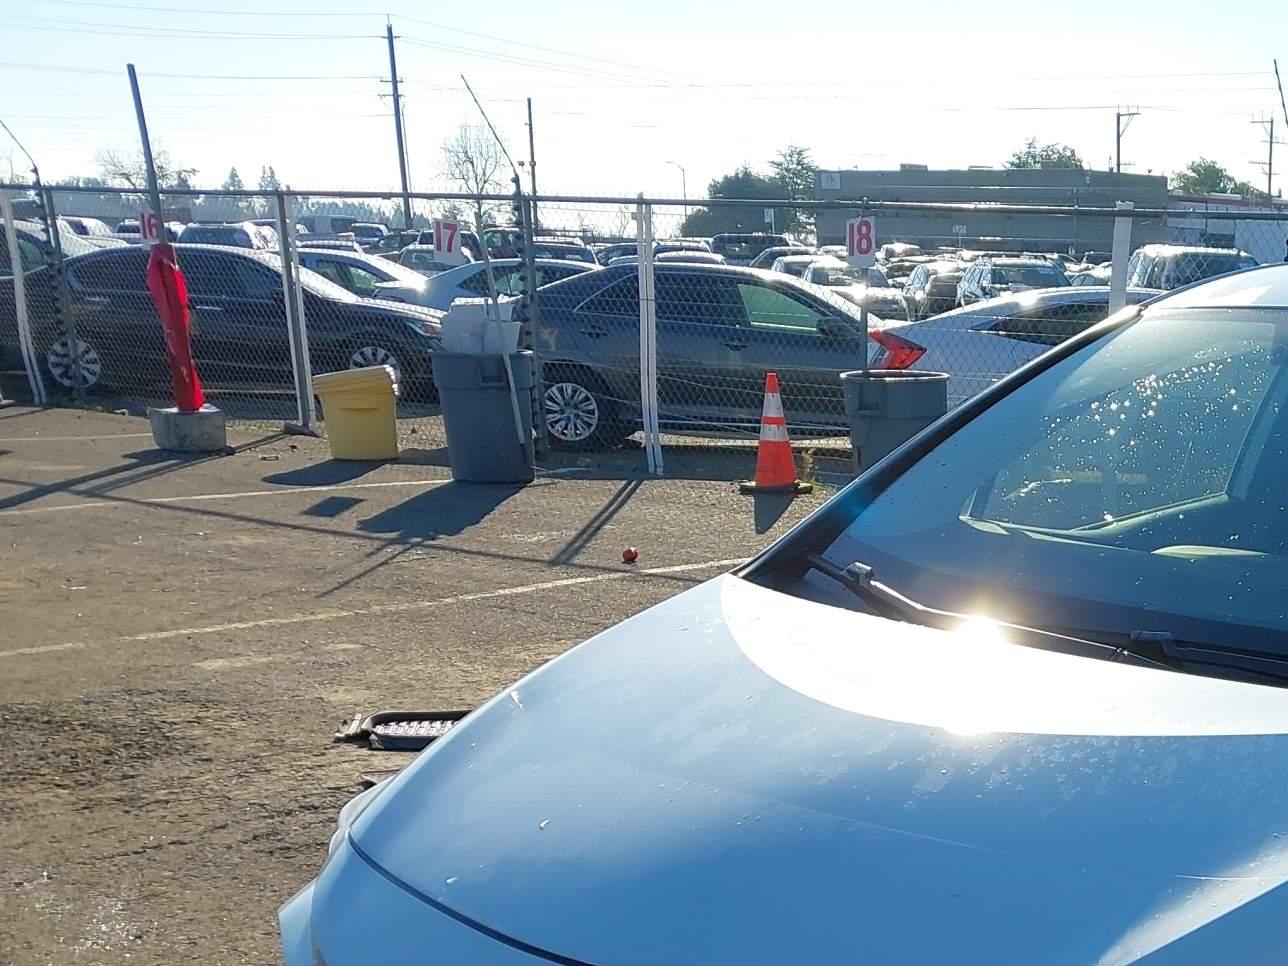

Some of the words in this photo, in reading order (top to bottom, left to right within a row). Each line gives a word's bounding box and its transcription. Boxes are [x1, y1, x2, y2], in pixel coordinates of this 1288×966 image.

[141, 212, 158, 240] 16
[435, 220, 458, 252] 17
[848, 220, 873, 257] 18
